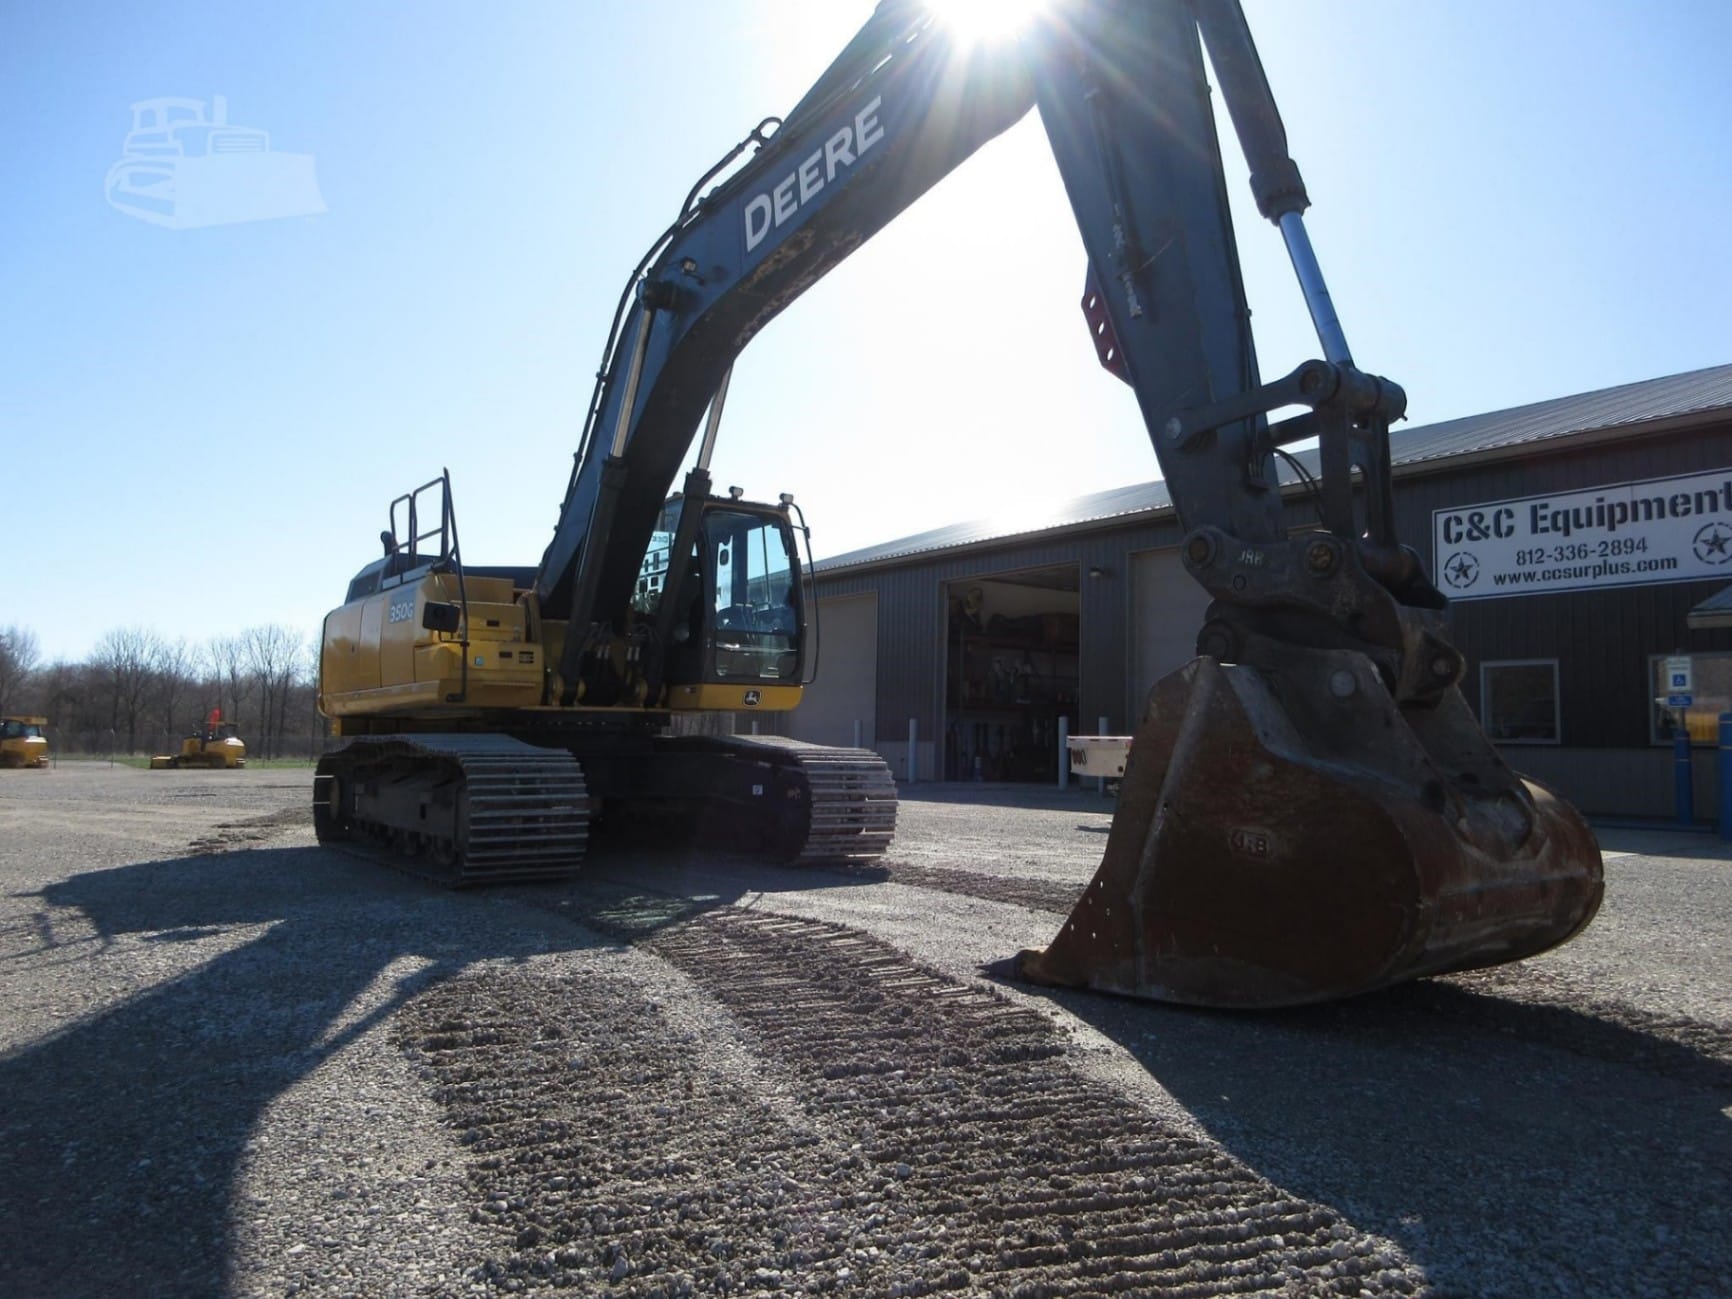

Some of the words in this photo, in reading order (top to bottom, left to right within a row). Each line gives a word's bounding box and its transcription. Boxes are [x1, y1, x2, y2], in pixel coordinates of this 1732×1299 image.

[744, 95, 885, 253] DEERE
[1443, 508, 1515, 545] C&C
[1530, 481, 1732, 537] Equipment
[1516, 537, 1648, 566] 812-336-2894
[1493, 557, 1678, 586] www.ccsurplus.com
[390, 602, 414, 623] 350G
